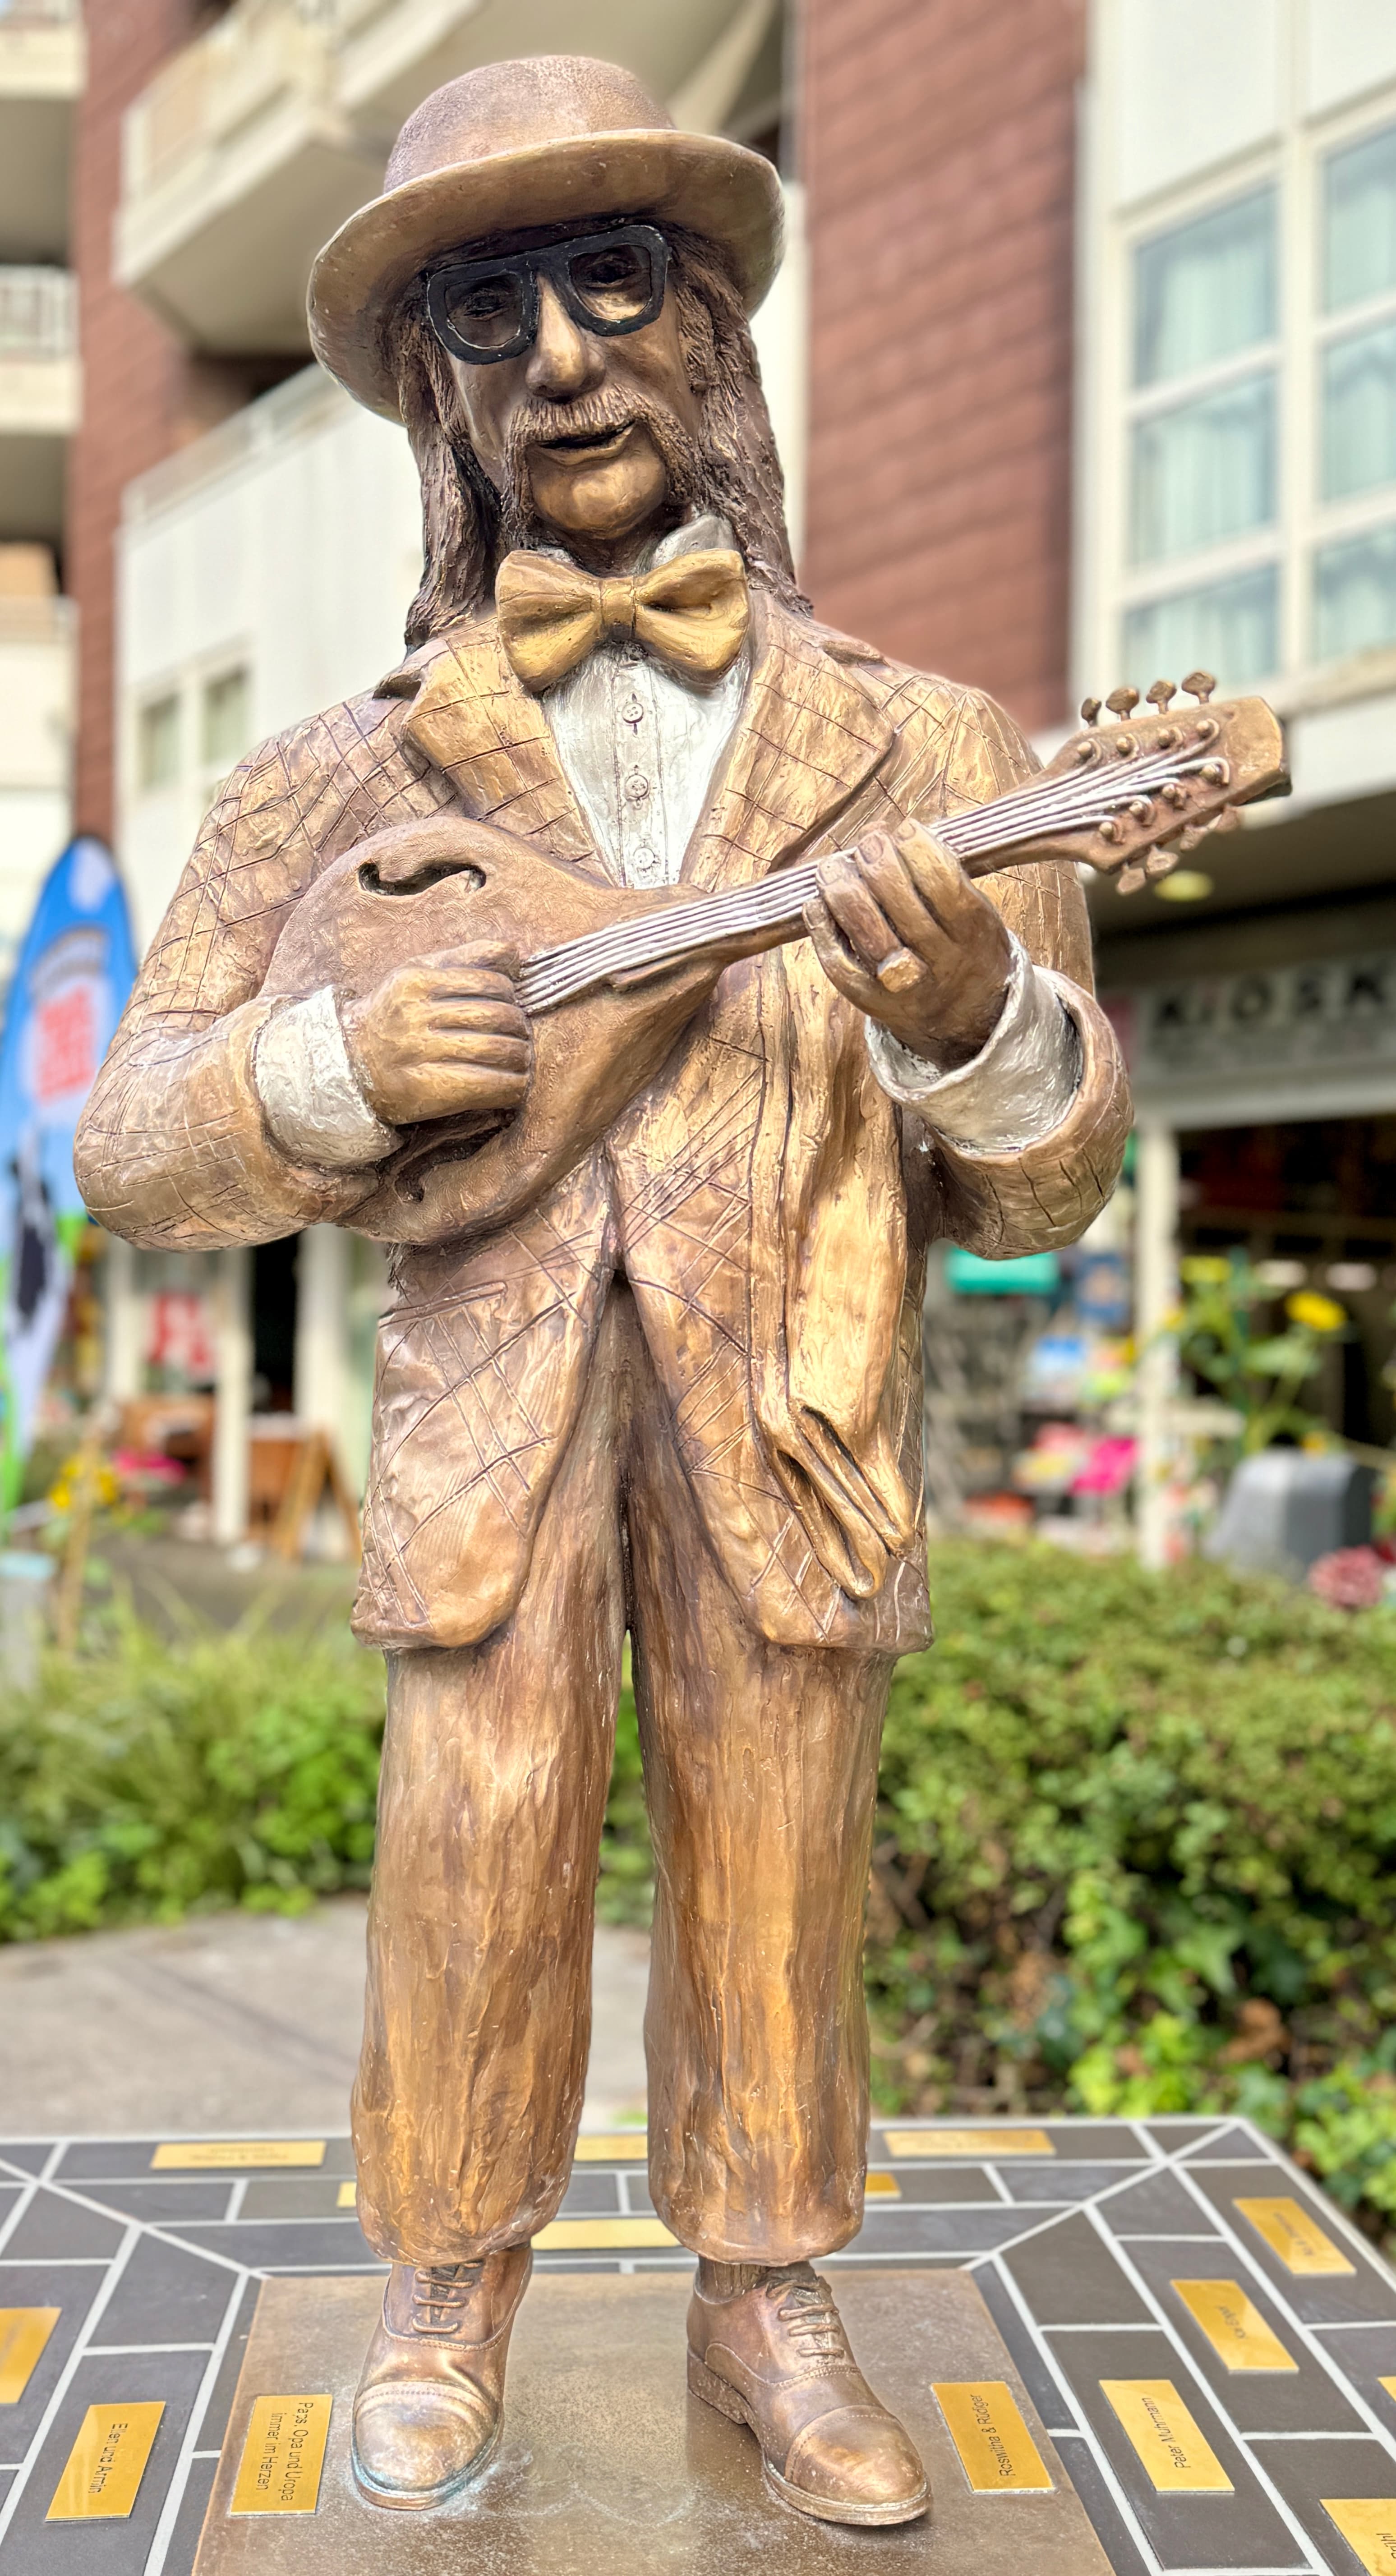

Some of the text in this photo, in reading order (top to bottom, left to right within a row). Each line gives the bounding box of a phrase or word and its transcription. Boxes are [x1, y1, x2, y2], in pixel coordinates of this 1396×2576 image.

[970, 2394, 992, 2424] Rüdiger
[256, 2413, 287, 2490] immer im Herzen
[288, 2429, 309, 2448] Opa
[88, 2423, 128, 2493] Ellen und Armin
[287, 2452, 303, 2469] und
[988, 2436, 1016, 2476] Roswitha
[1168, 2445, 1191, 2468] Peter
[278, 2471, 303, 2501] Uropa
